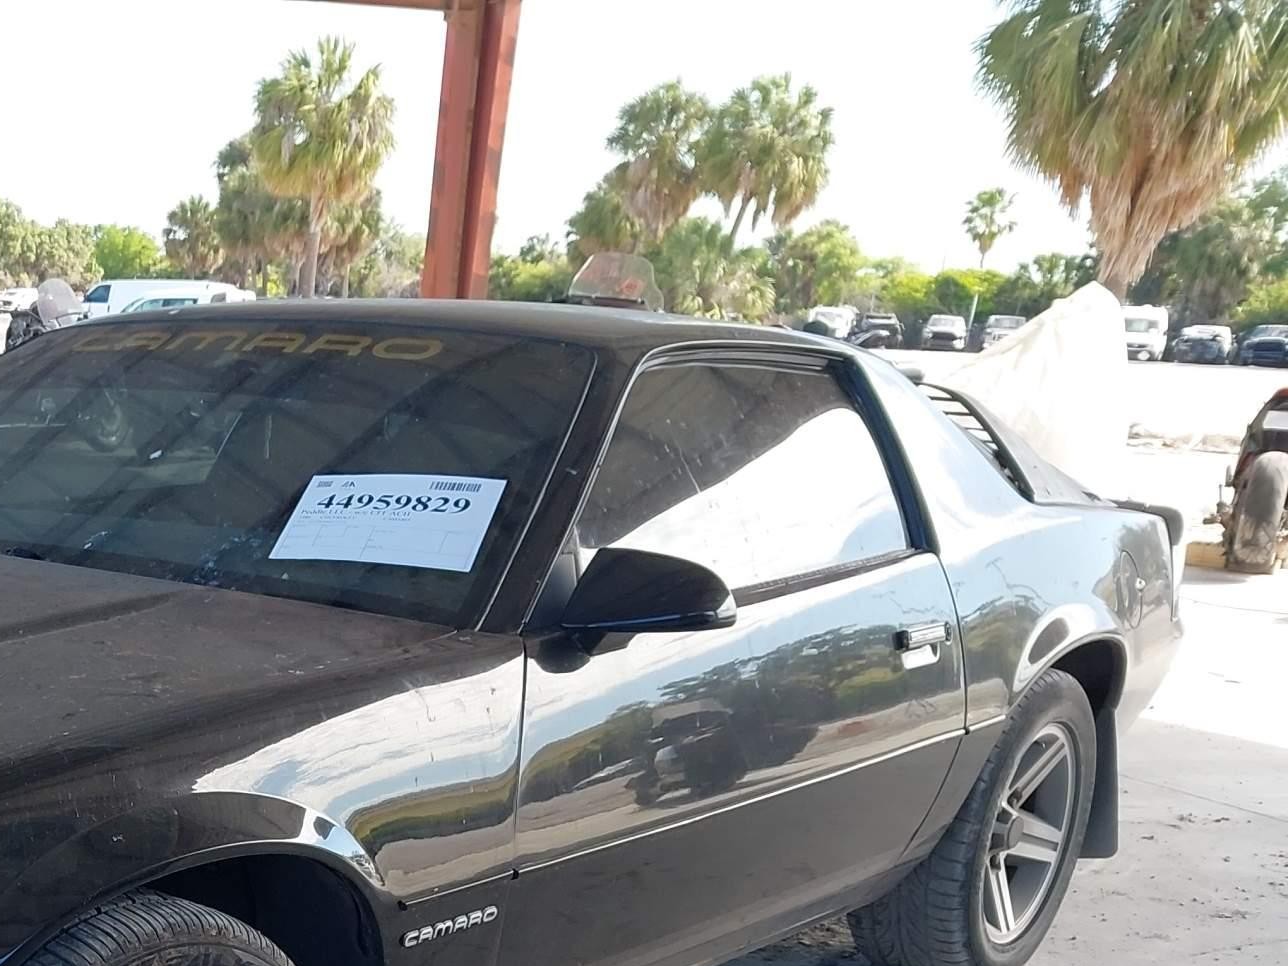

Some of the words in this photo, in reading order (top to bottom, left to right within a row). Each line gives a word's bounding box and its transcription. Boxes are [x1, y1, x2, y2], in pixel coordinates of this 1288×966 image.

[73, 331, 443, 360] CAMARO
[316, 493, 471, 514] 44959829
[404, 905, 498, 948] CAMARO
